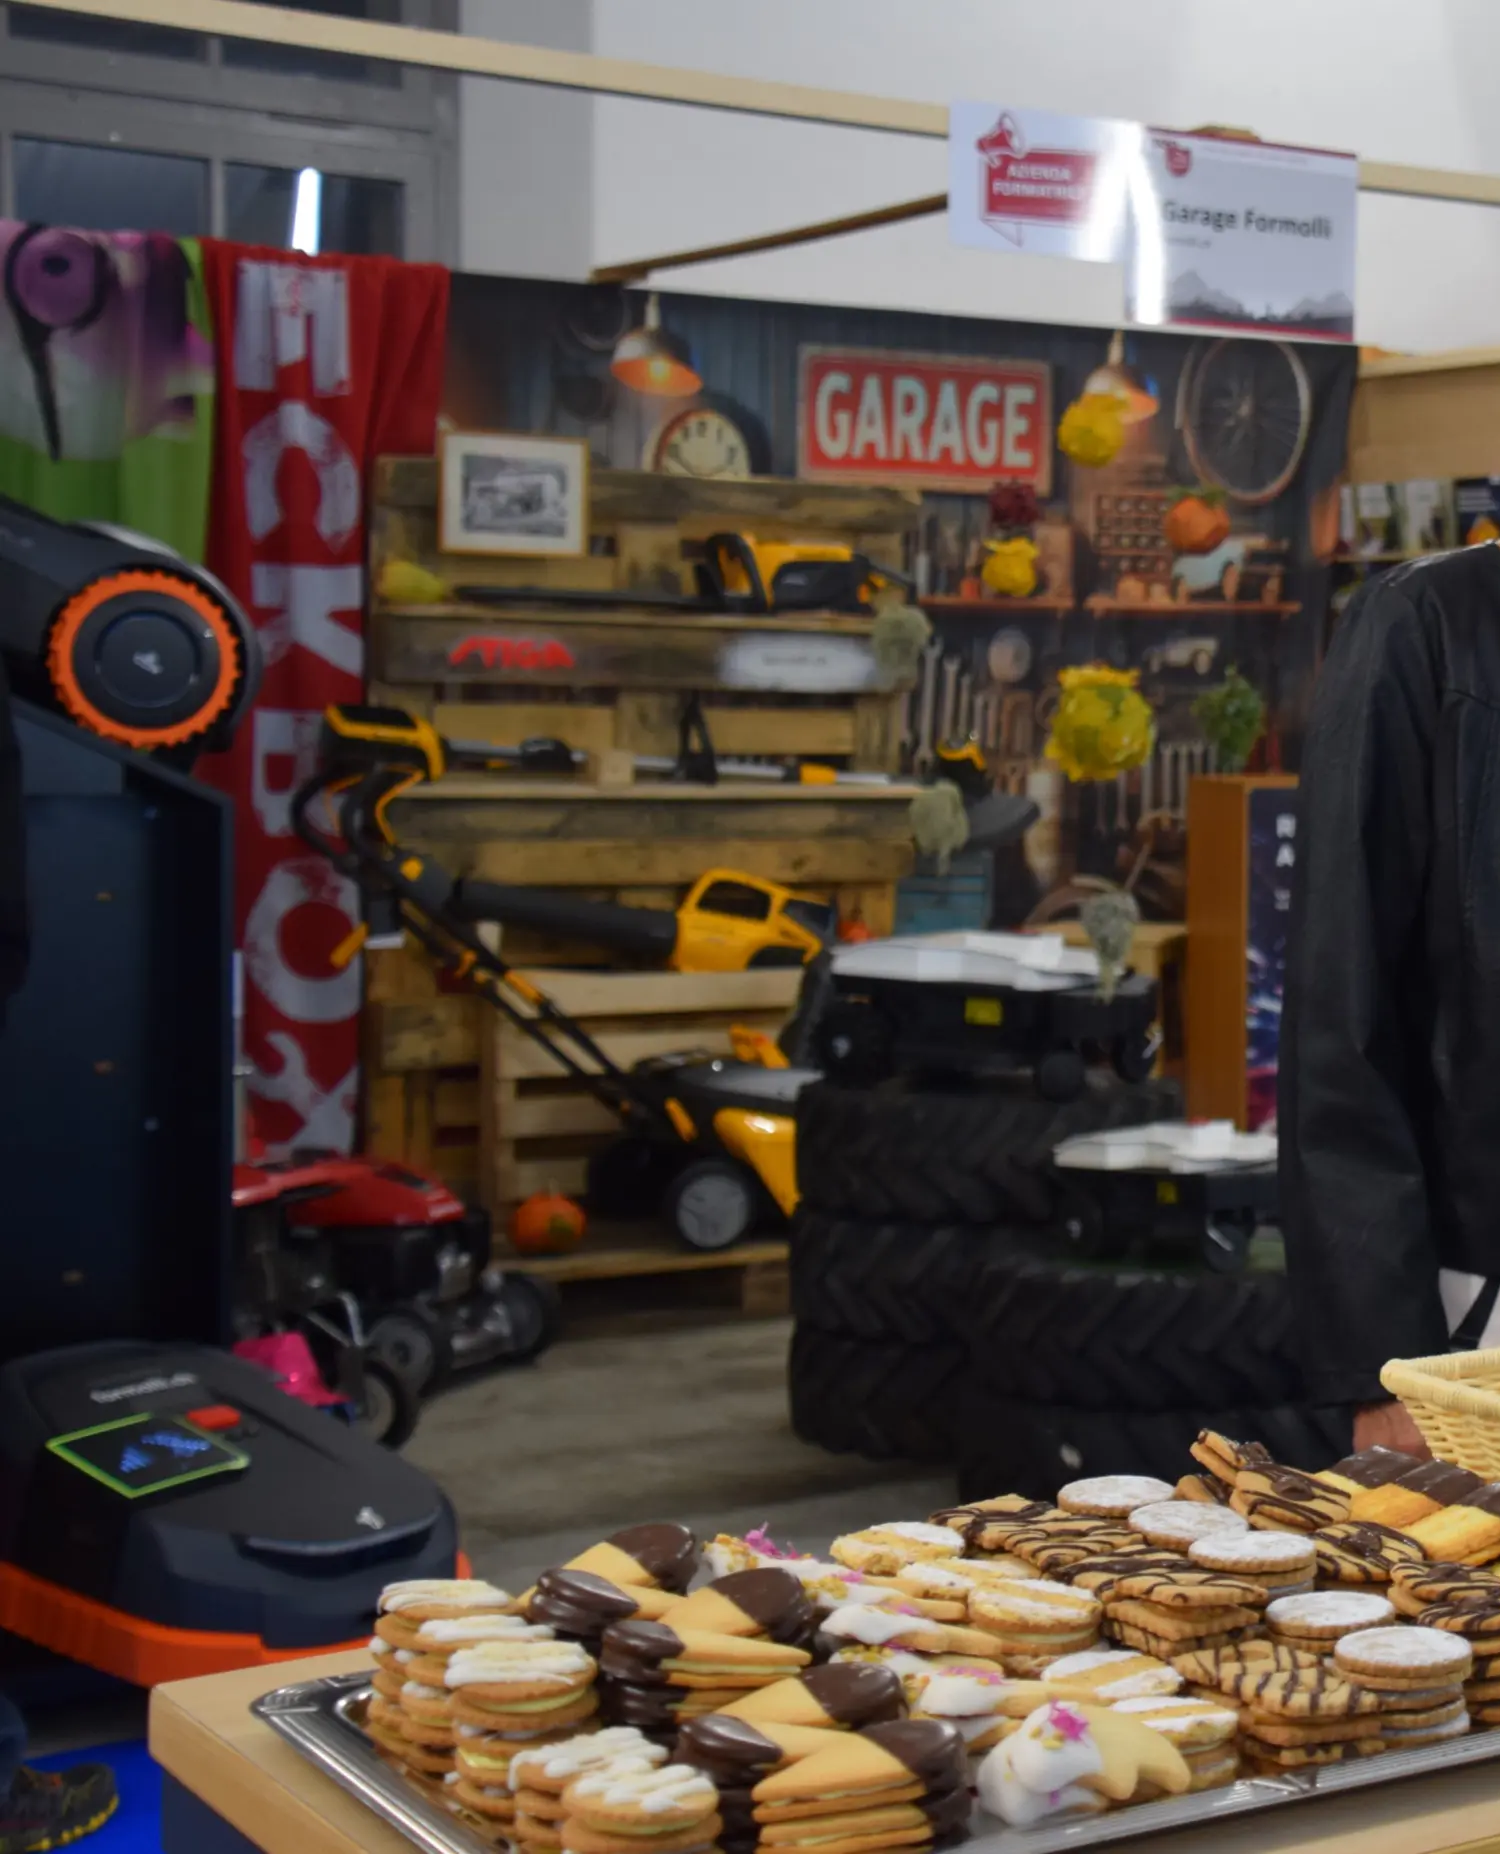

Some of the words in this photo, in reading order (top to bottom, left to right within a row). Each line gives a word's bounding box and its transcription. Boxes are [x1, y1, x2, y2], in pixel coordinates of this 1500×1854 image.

[1163, 201, 1237, 232] Garage
[1244, 208, 1333, 239] Formolli
[815, 371, 1036, 468] GARAGE
